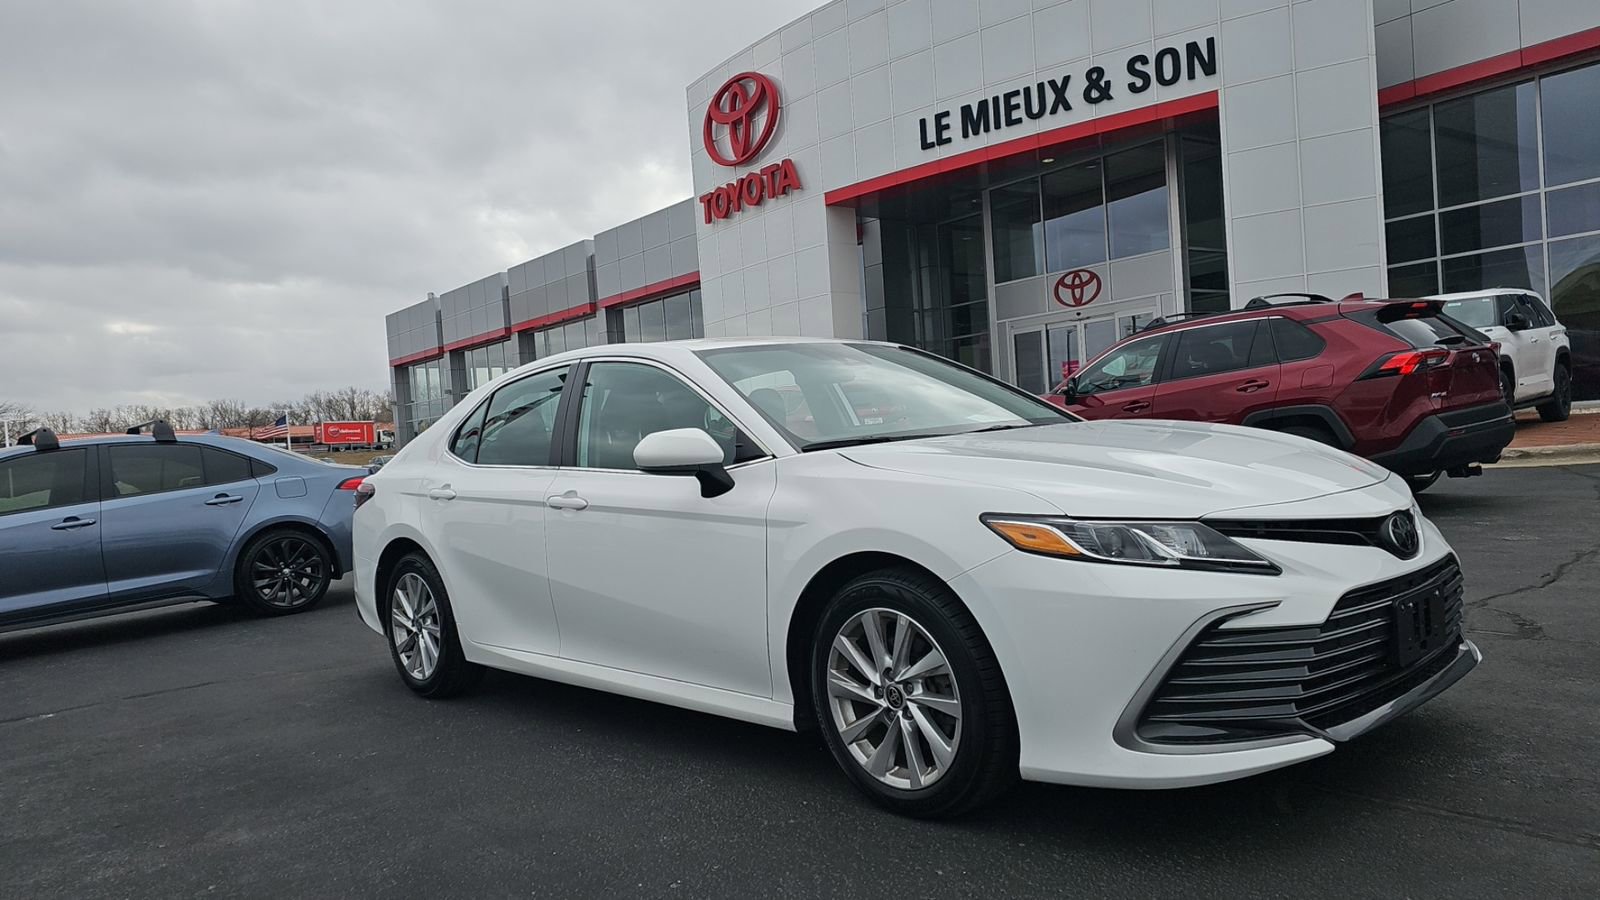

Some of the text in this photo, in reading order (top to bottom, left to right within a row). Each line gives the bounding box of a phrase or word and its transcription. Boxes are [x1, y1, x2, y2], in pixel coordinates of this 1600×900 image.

[919, 36, 1217, 151] LE MIEUX & SON
[699, 158, 801, 224] TOYOTA
